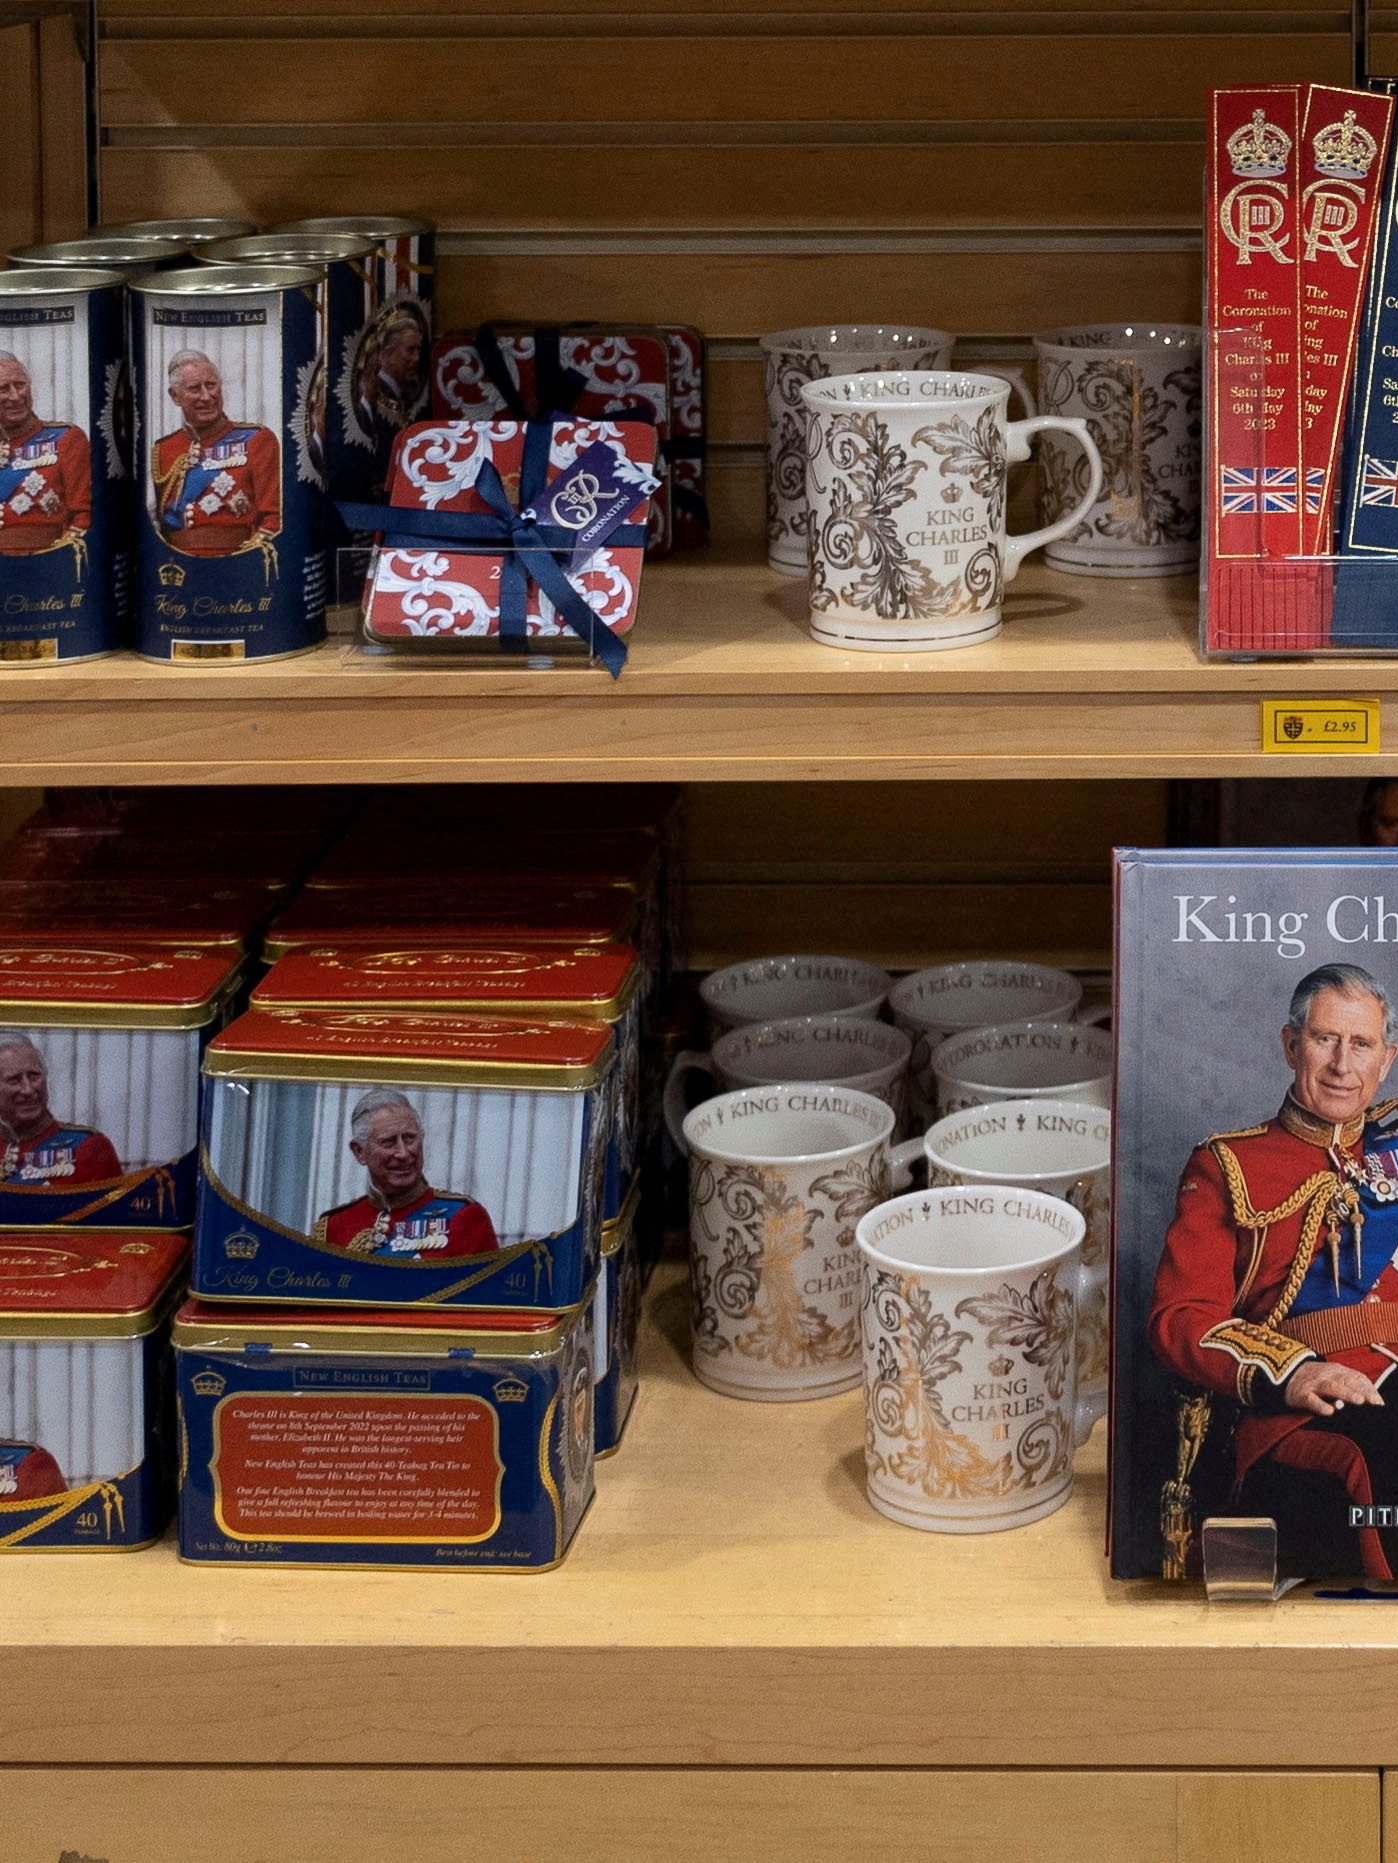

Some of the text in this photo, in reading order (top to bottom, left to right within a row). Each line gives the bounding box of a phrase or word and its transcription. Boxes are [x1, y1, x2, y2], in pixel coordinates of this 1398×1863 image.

[1245, 289, 1269, 300] The
[1305, 284, 1328, 299] The
[44, 309, 74, 320] TEAS
[236, 310, 265, 322] TEAS
[1223, 305, 1291, 317] Coronation
[1305, 320, 1319, 330] of
[1276, 353, 1289, 364] III
[1323, 353, 1339, 366] III
[1232, 403, 1254, 414] 6th
[582, 494, 631, 543] CORONATION
[926, 507, 975, 523] KING
[905, 525, 988, 547] CHARLES
[943, 550, 960, 566] III
[4, 590, 85, 614] Charles III
[155, 590, 272, 620] King Charles III
[60, 621, 76, 629] TEA
[1323, 721, 1357, 733] £2.95
[1172, 895, 1308, 959] King
[731, 1097, 779, 1119] KING
[1036, 1115, 1088, 1136] KING
[130, 1197, 151, 1211] 40
[940, 1199, 1073, 1239] KING CHARLES
[202, 1265, 353, 1291] King Charles III
[504, 1272, 527, 1288] 40
[839, 1291, 853, 1309] III
[300, 1370, 427, 1384] NEW ENGLISH TEAS
[972, 1378, 1029, 1399] KING
[232, 1409, 265, 1419] Charles
[266, 1410, 278, 1419] III
[289, 1410, 309, 1421] King
[310, 1410, 319, 1421] of
[321, 1411, 334, 1419] the
[335, 1411, 363, 1420] United
[407, 1412, 417, 1420] He
[467, 1412, 480, 1420] the
[952, 1394, 1045, 1422] CHARLES
[248, 1421, 273, 1430] throne
[289, 1422, 302, 1430] 8th
[304, 1422, 347, 1433] September
[349, 1422, 370, 1431] 2022
[371, 1423, 393, 1433] upon
[394, 1423, 407, 1431] the
[408, 1423, 441, 1434] passing
[442, 1423, 451, 1434] of
[453, 1423, 465, 1432] his
[992, 1423, 1010, 1441] III
[283, 1432, 322, 1442] Elizabeth
[335, 1433, 346, 1442] He
[349, 1435, 365, 1443] was
[366, 1434, 380, 1443] the
[382, 1434, 445, 1445] longest-serving
[446, 1435, 464, 1443] heir
[245, 1459, 263, 1468] New
[265, 1460, 297, 1470] English
[298, 1460, 316, 1469] Teas
[318, 1460, 333, 1469] has
[334, 1460, 366, 1470] created
[367, 1461, 383, 1470] this
[429, 1461, 444, 1470] Tea
[446, 1461, 460, 1470] Tin
[461, 1462, 471, 1470] to
[75, 1512, 99, 1528] 40
